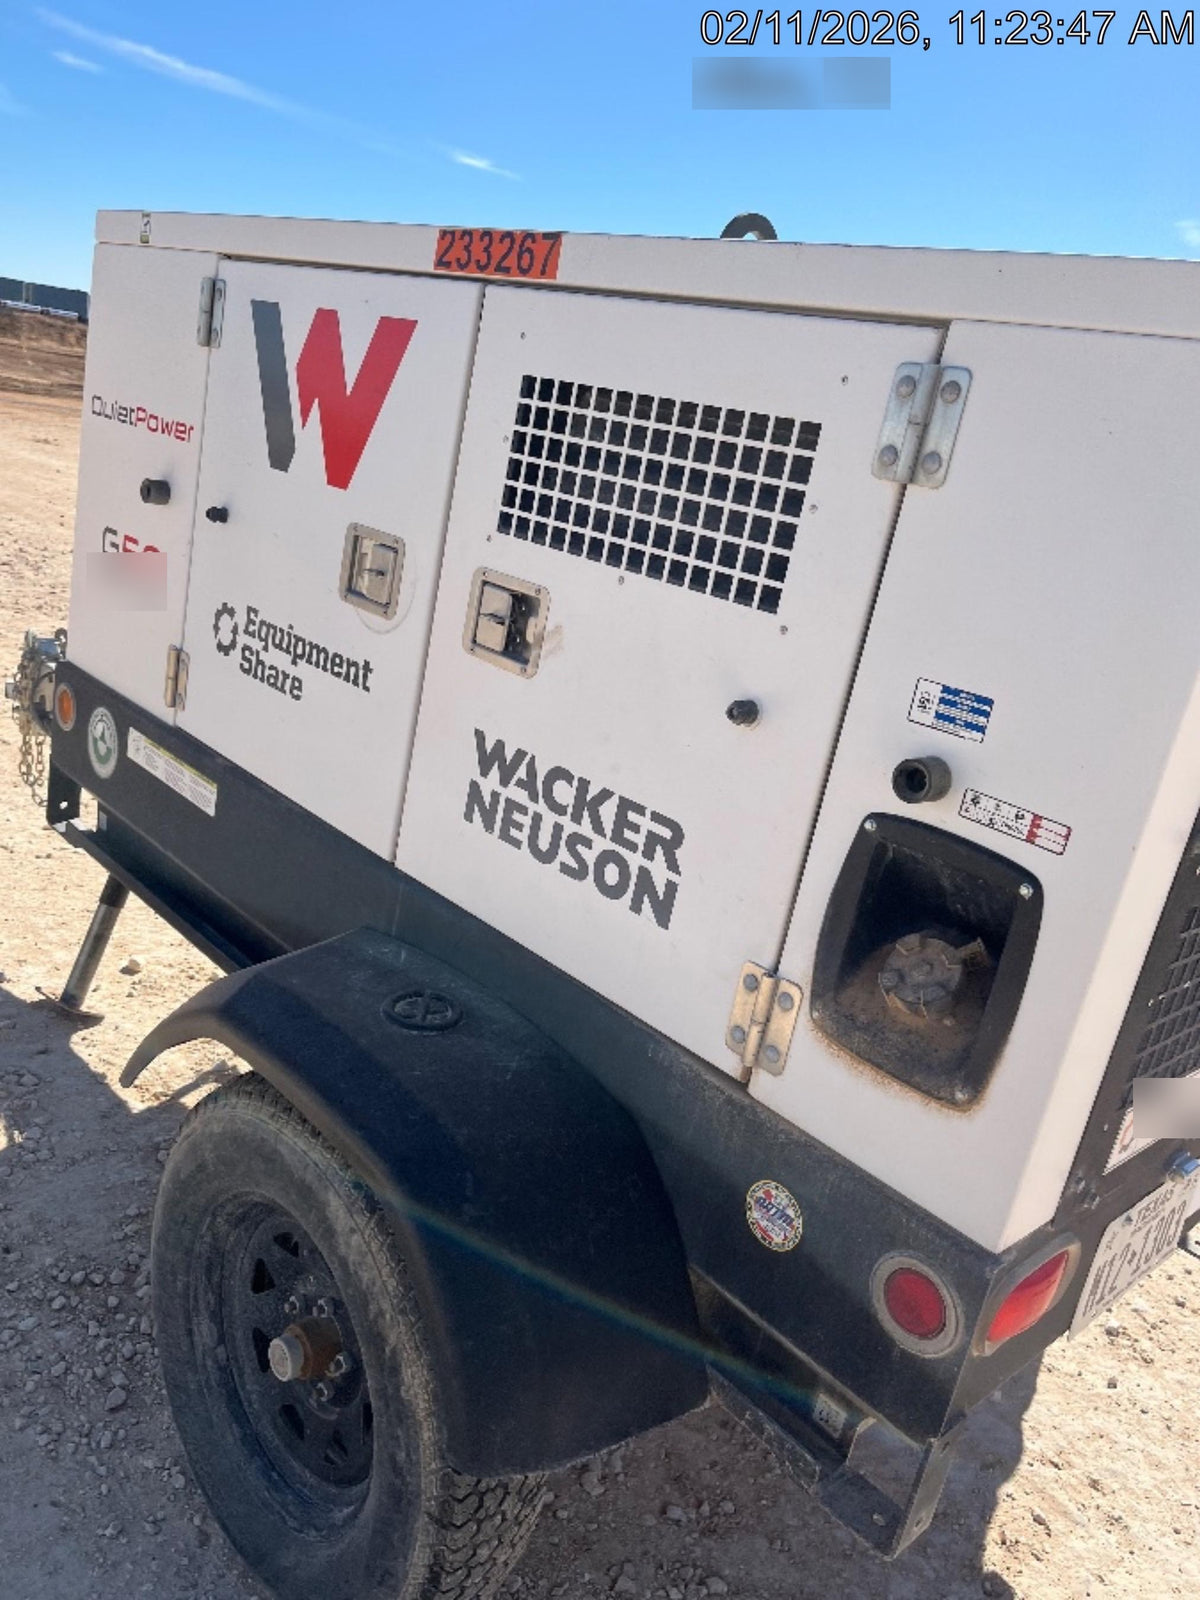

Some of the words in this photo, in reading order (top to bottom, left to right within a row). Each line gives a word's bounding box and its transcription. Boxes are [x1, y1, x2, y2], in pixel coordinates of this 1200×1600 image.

[435, 228, 561, 279] 233267
[91, 394, 195, 442] QuietPower
[239, 646, 304, 702] Share
[243, 604, 374, 694] Equipment
[474, 727, 685, 876] WACKER
[464, 778, 679, 930] NEUSON
